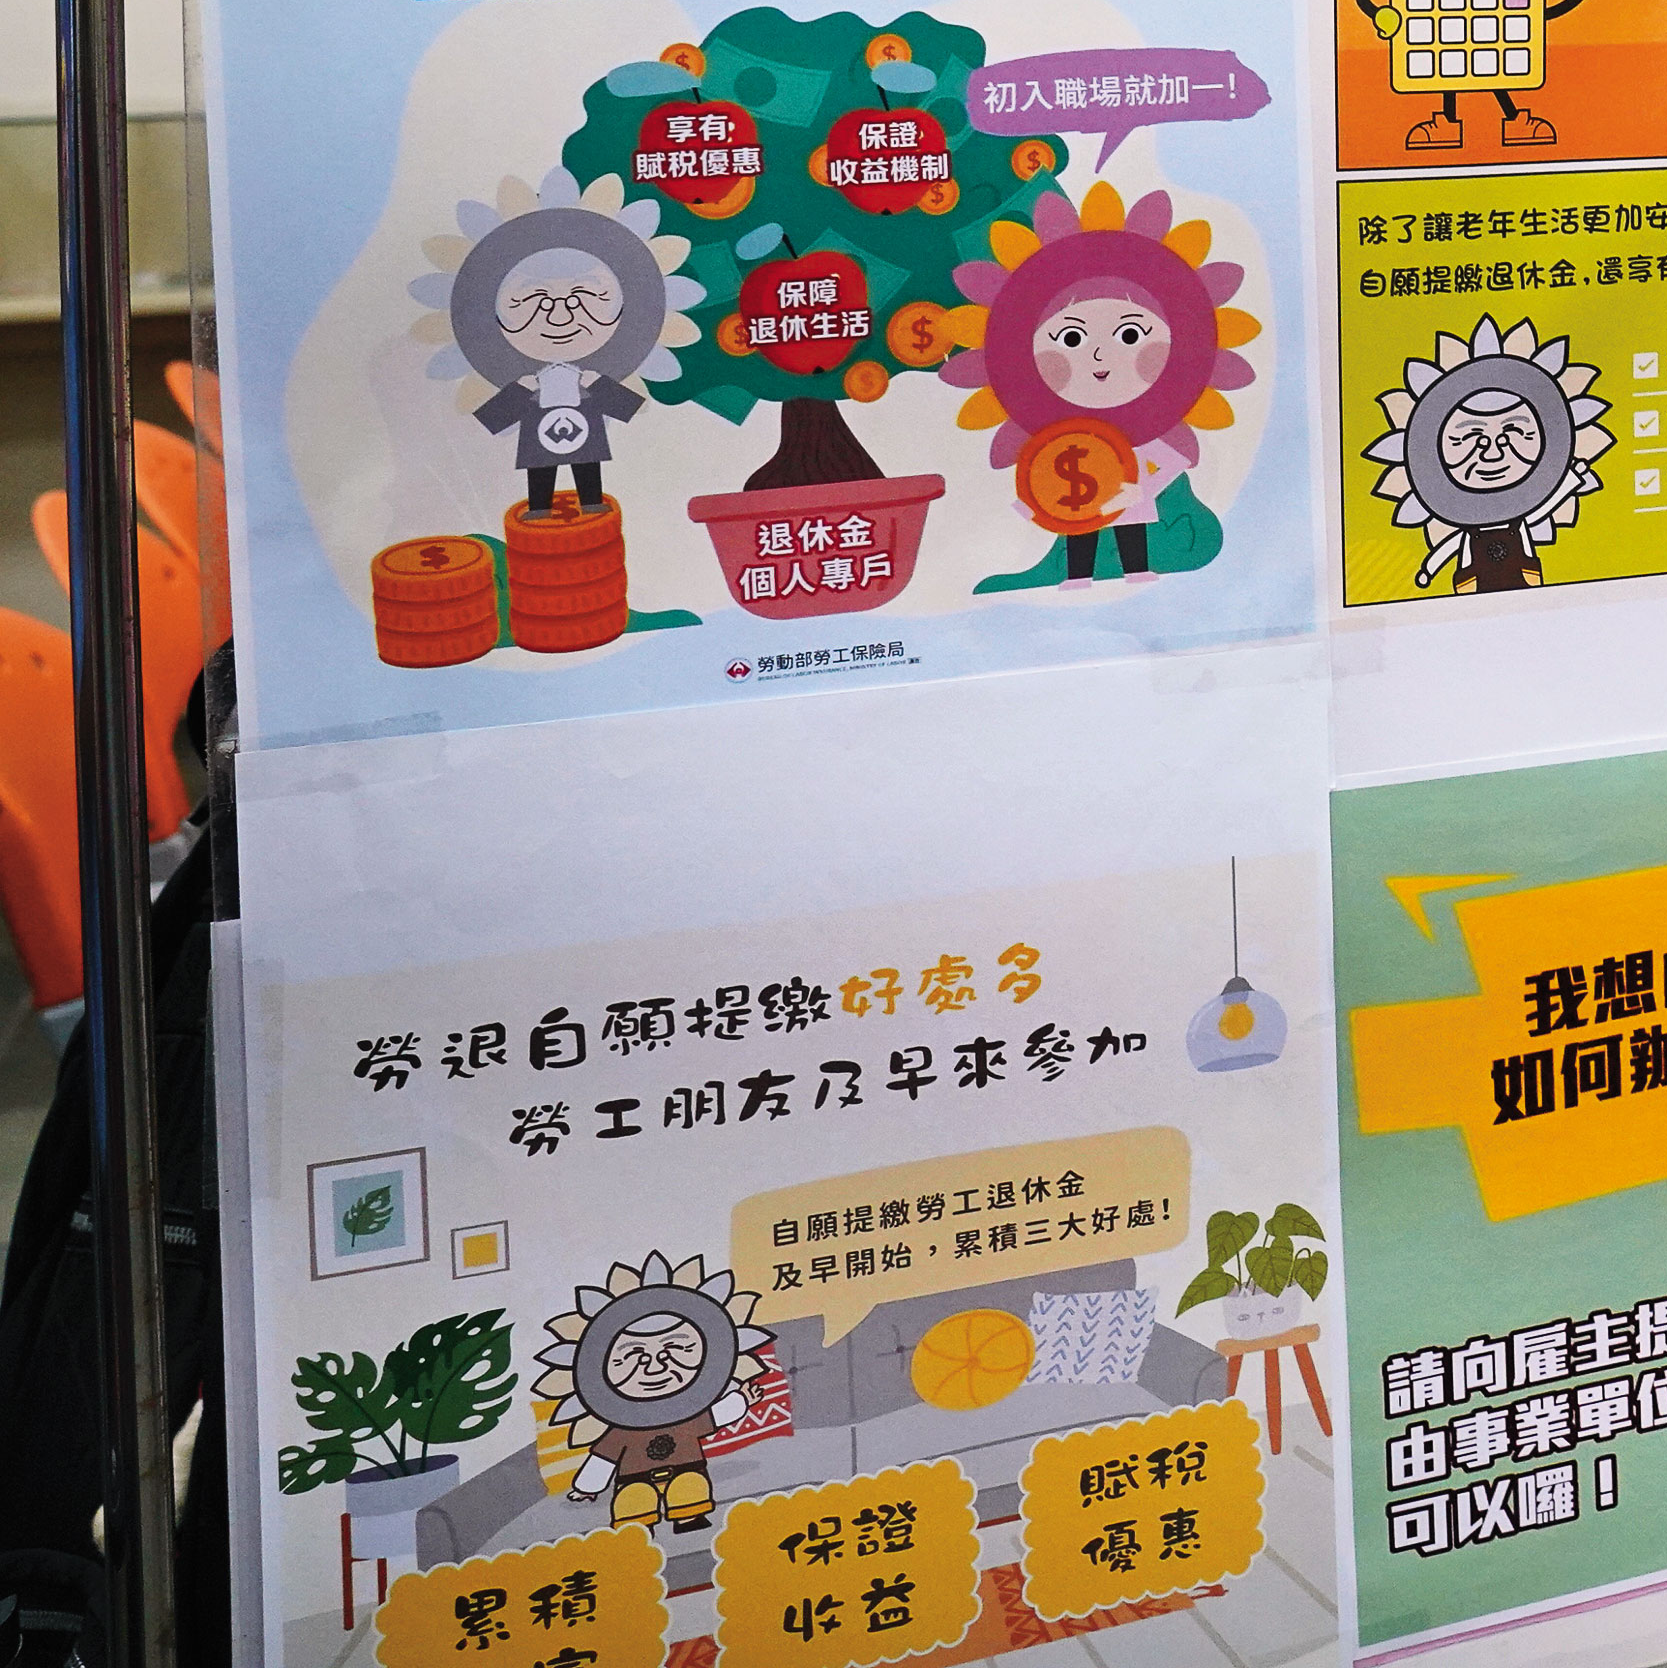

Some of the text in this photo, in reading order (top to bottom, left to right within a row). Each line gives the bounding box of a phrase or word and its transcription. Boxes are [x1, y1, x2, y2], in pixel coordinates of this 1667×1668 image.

[666, 114, 732, 143] 享有
[858, 122, 920, 150] 保證
[635, 147, 763, 182] 賦稅優惠
[829, 153, 952, 185] 收益機制
[777, 278, 838, 309] 保障
[748, 310, 871, 344] 退休生活
[757, 517, 875, 558] 退休金
[740, 554, 894, 599] 個人專戶
[757, 640, 905, 674] 勞動部勞工保險局
[354, 941, 1045, 1093] 勞退自願提繳好處多
[508, 1023, 1149, 1159] 勞工朋友及早來參加
[772, 1169, 1086, 1248] 自願提繳勞工退休金
[1078, 1439, 1211, 1512] 賦稅
[782, 1501, 920, 1567] 保證
[1386, 1454, 1622, 1559] 可以囉！
[1081, 1506, 1203, 1575] 優惠
[454, 1569, 598, 1651] 累積
[783, 1575, 918, 1643] 收益
